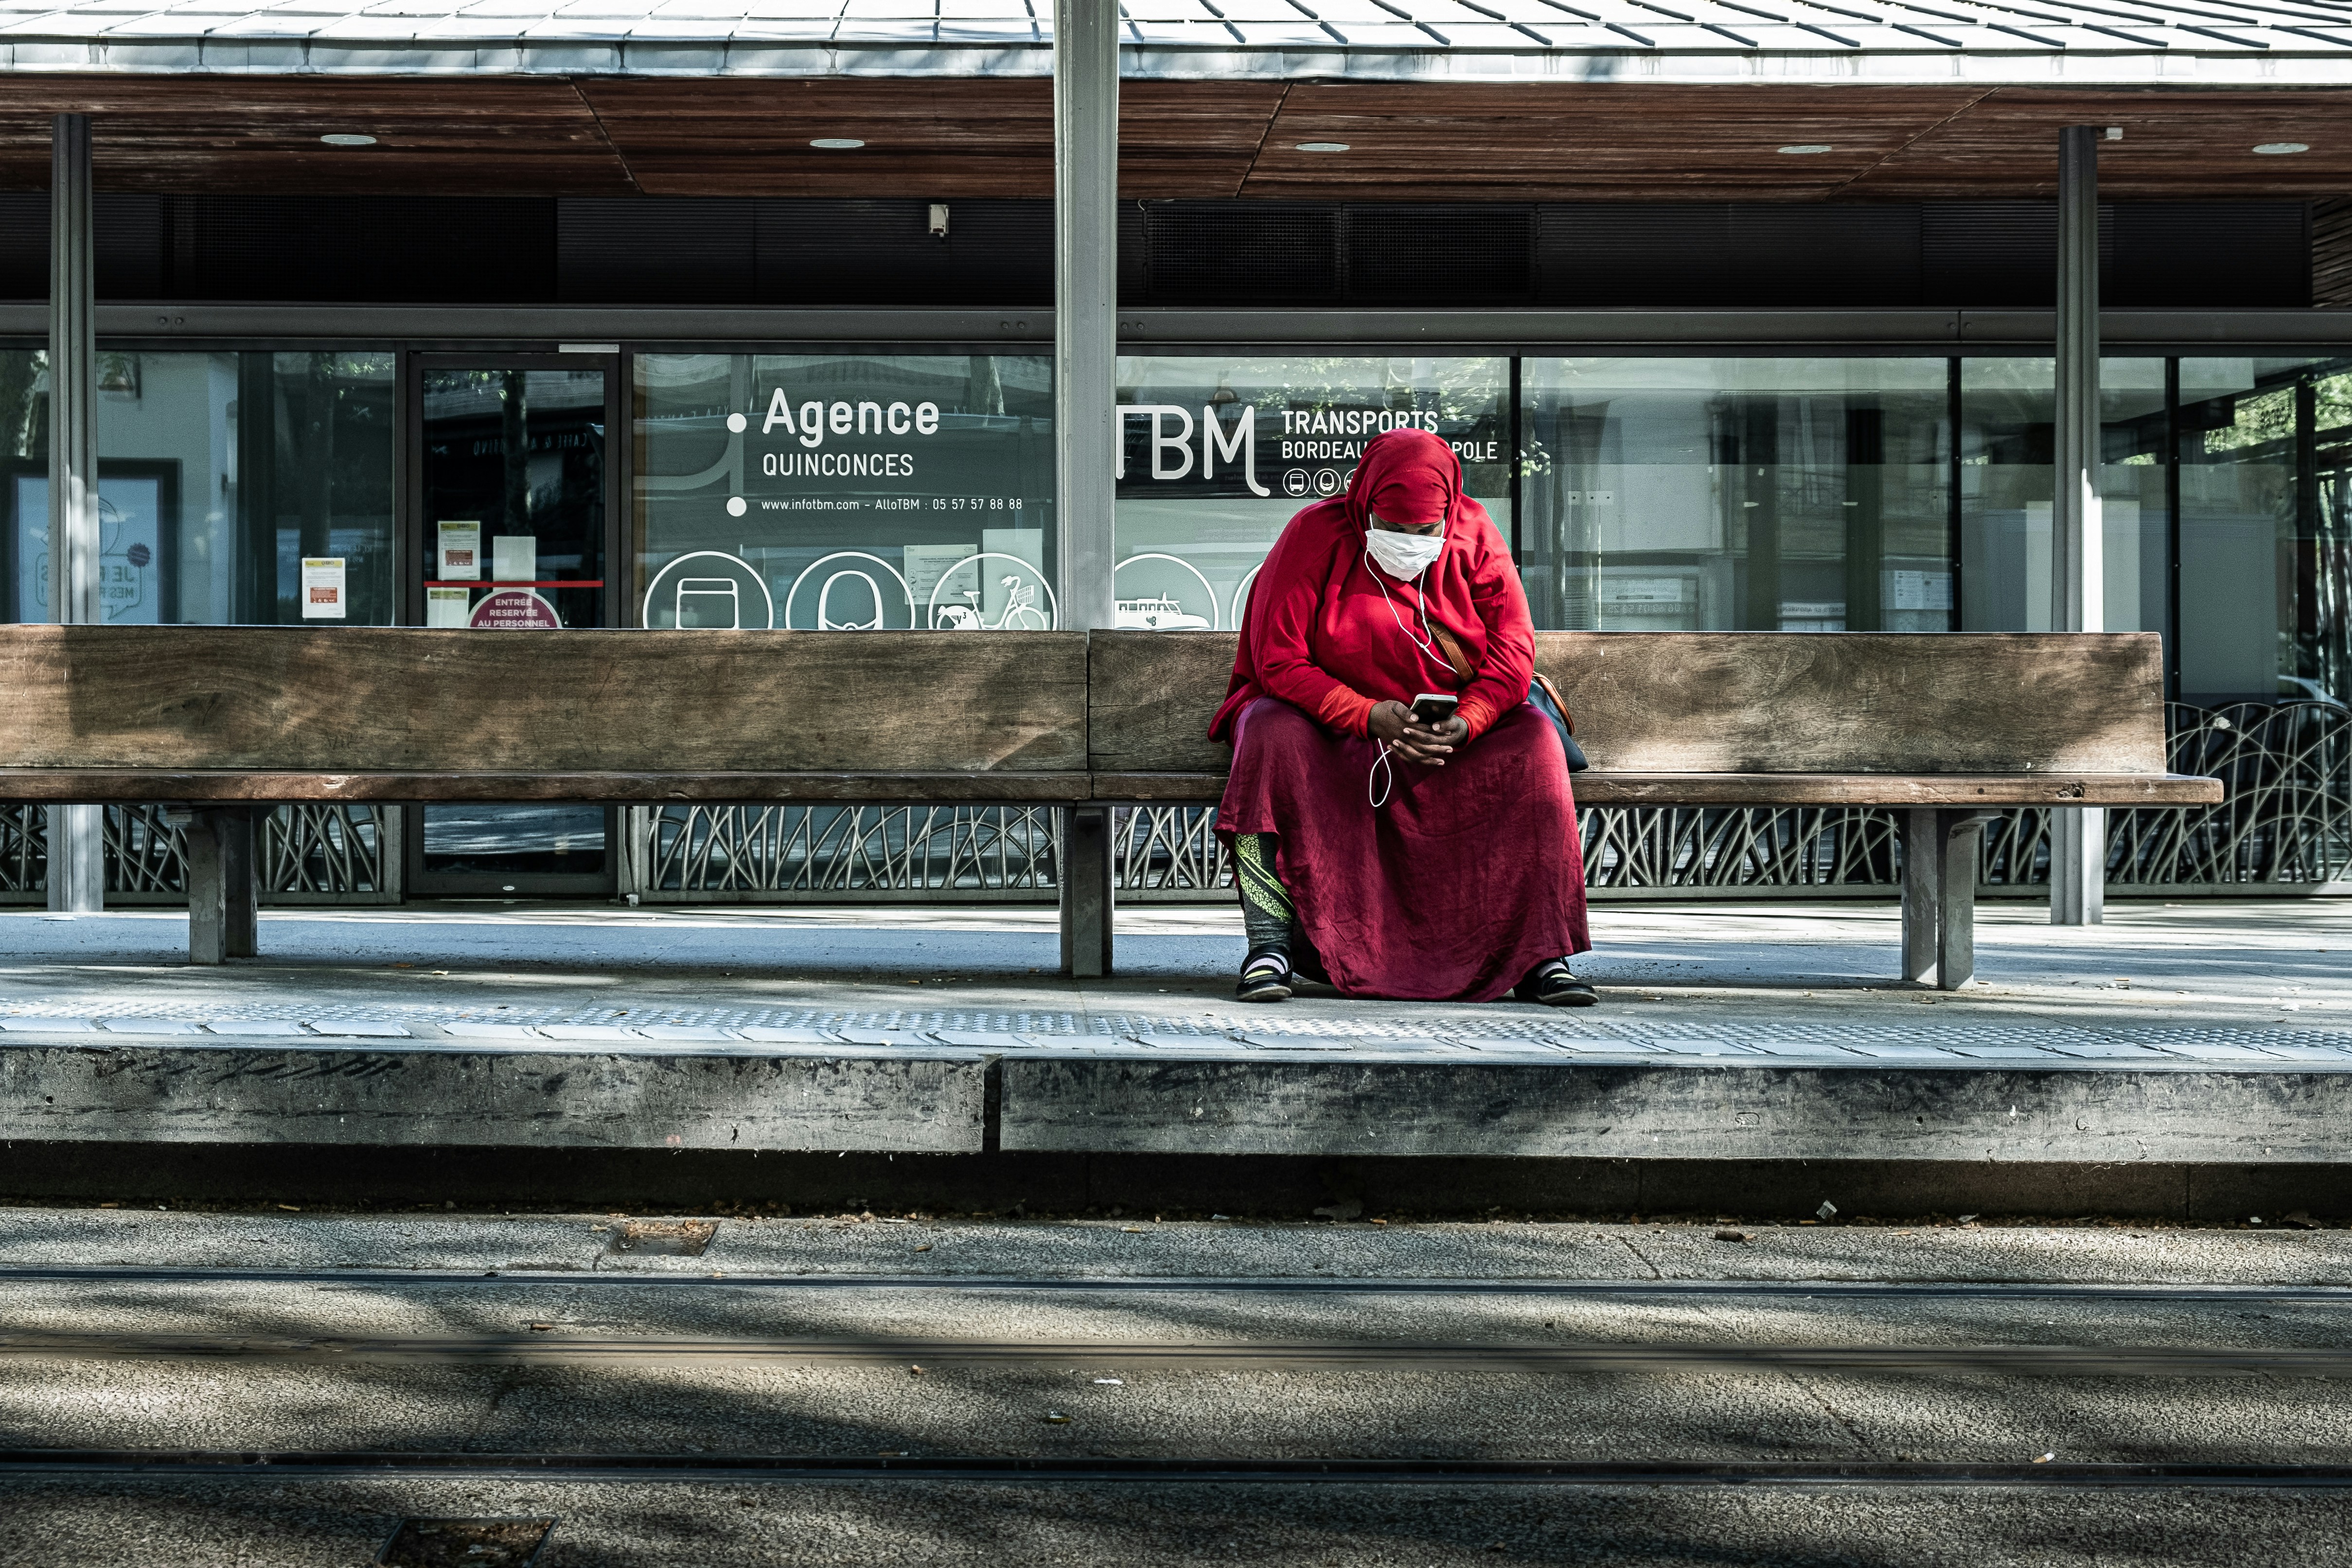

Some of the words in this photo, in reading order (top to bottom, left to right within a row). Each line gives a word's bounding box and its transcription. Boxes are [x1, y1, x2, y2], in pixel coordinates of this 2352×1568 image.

[762, 388, 939, 448] Agence
[1281, 410, 1438, 435] TRANSPORTS
[1282, 441, 1368, 459] BORDEAU
[1446, 441, 1498, 459] POLE
[763, 453, 913, 476] QUINCONCES
[761, 498, 859, 510] www.infotbm.com
[875, 498, 919, 510] AlloTBM
[933, 498, 946, 510] 05
[952, 498, 965, 510] 57
[971, 498, 984, 510] 57
[990, 498, 1003, 510] 88
[1009, 498, 1022, 510] 88
[495, 597, 532, 606] ENTRÉE
